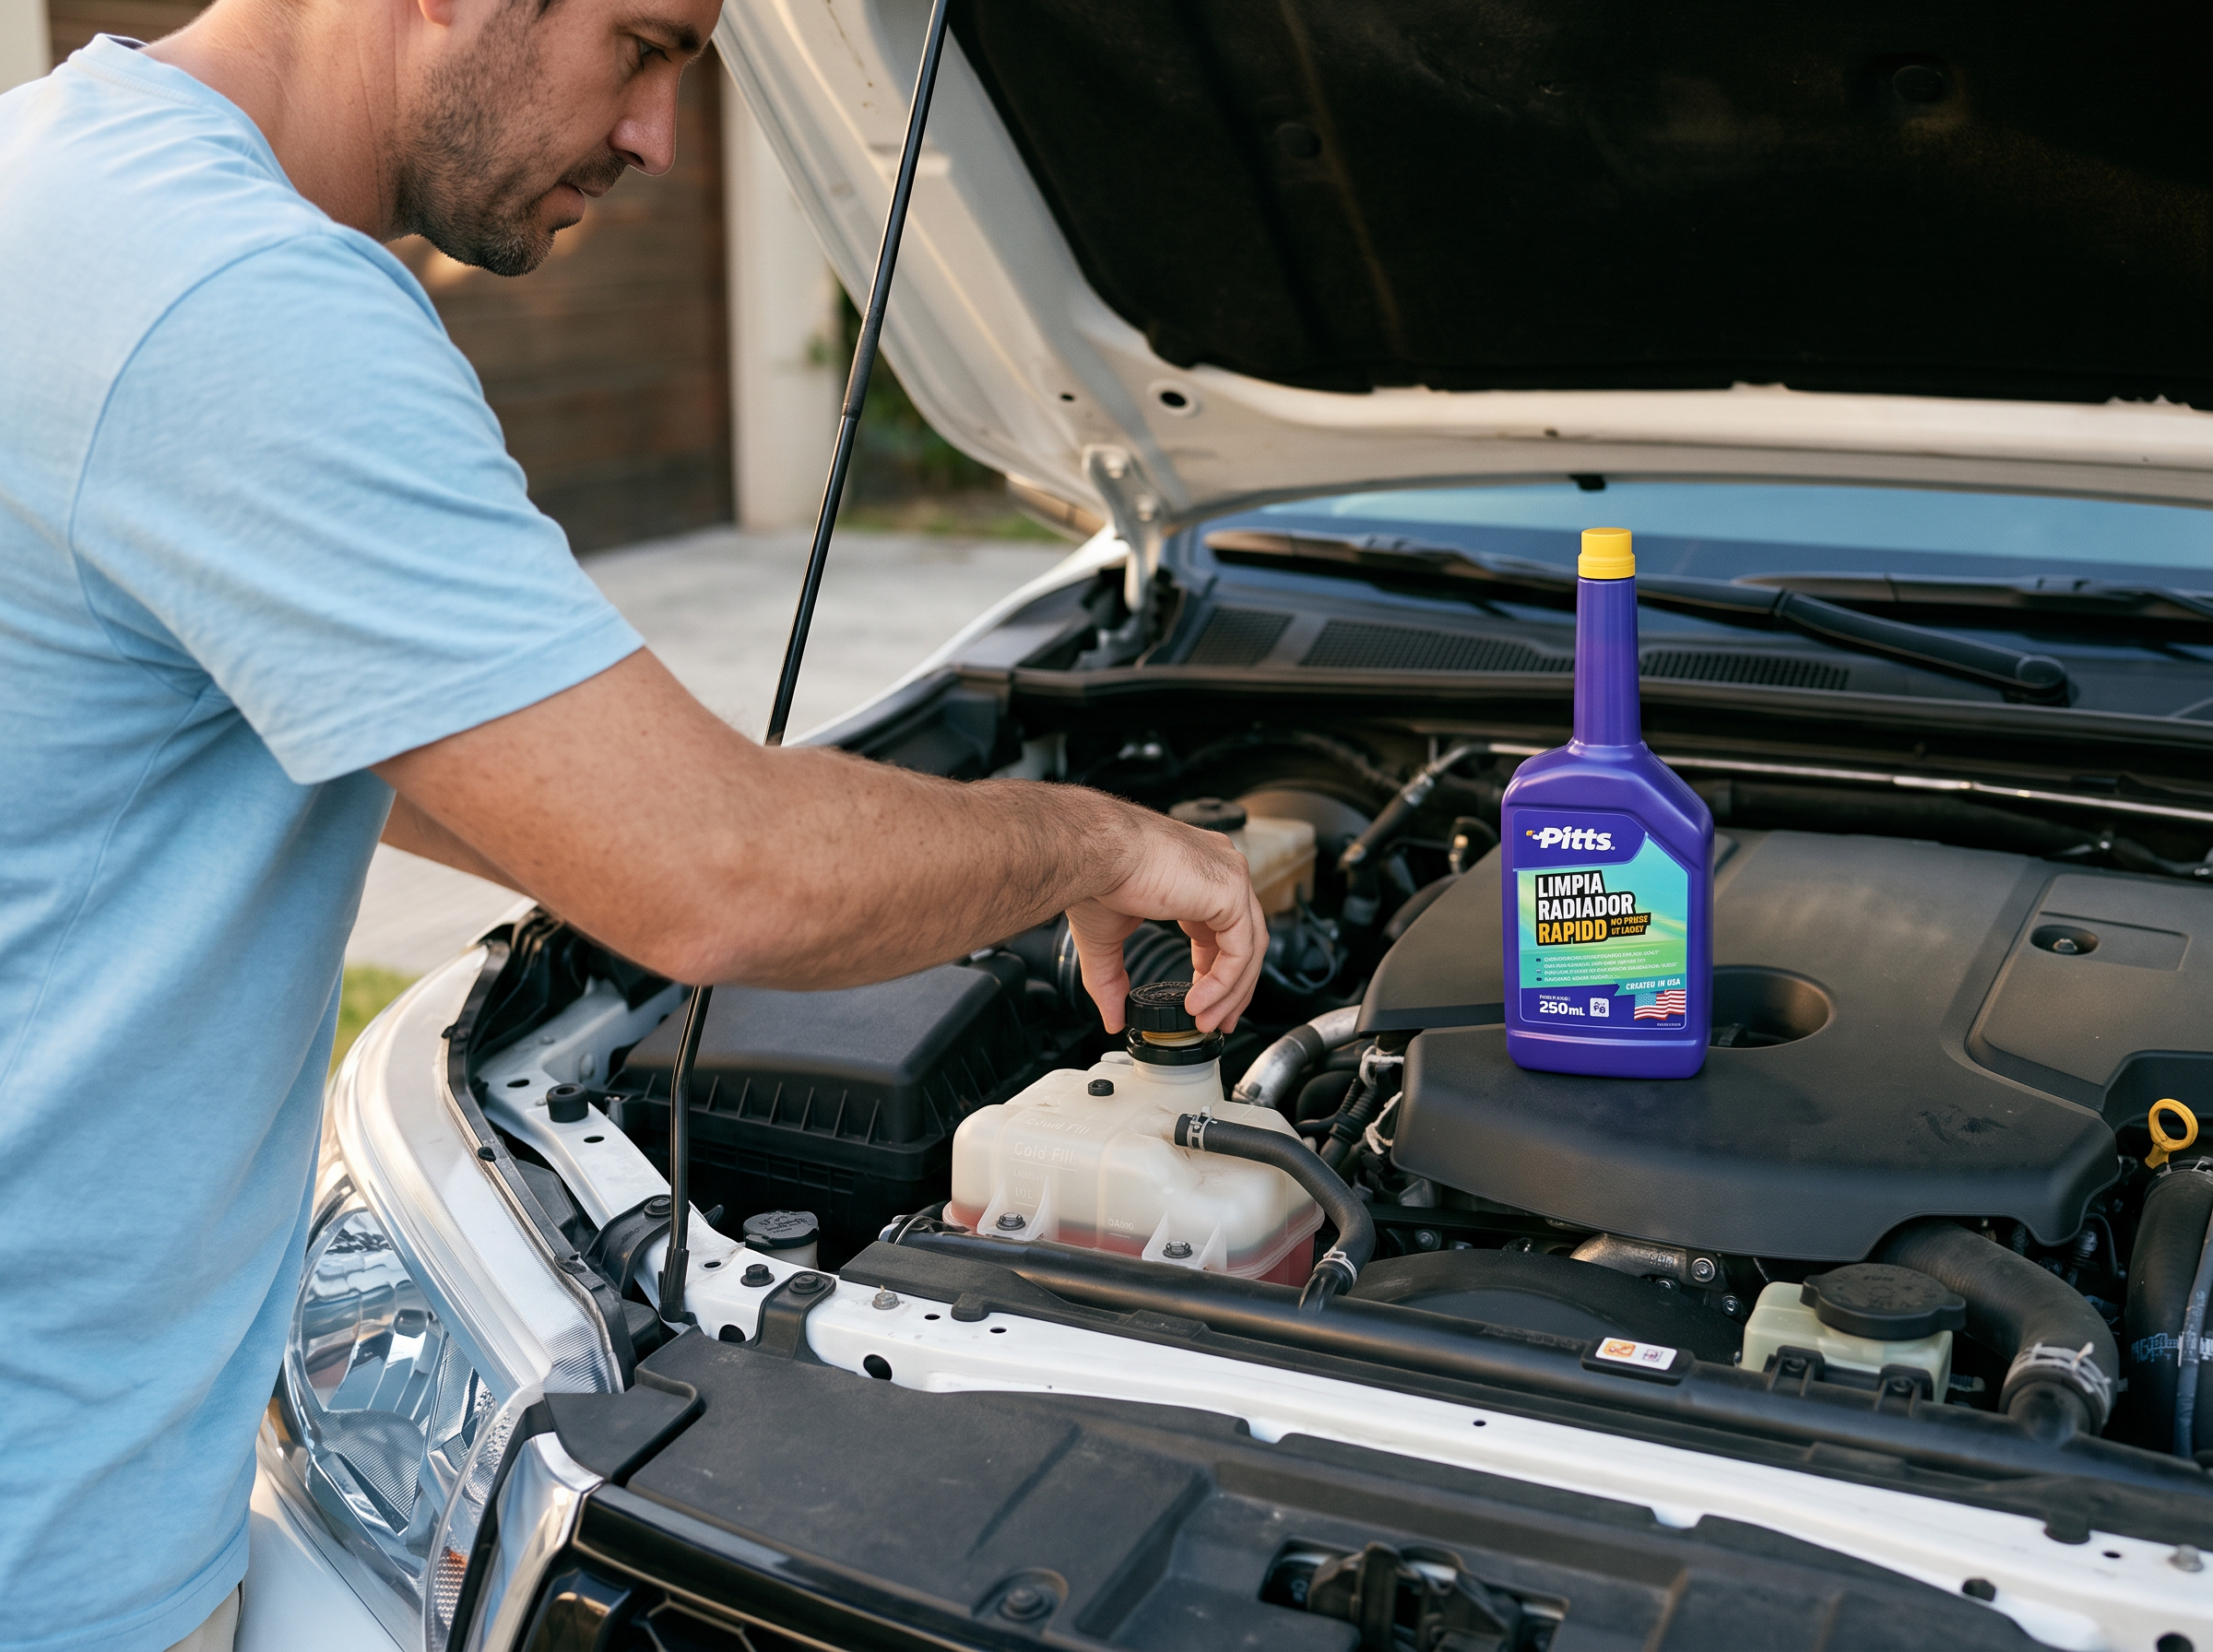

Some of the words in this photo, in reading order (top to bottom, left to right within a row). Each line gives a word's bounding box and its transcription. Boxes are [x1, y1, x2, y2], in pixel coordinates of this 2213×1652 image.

[1533, 826, 1612, 851] Pitts
[1538, 872, 1604, 898] LIMPIA
[1538, 894, 1633, 920] RADIADOR
[1657, 979, 1665, 987] IN
[1667, 977, 1681, 986] USA
[1014, 1141, 1047, 1160] Cold
